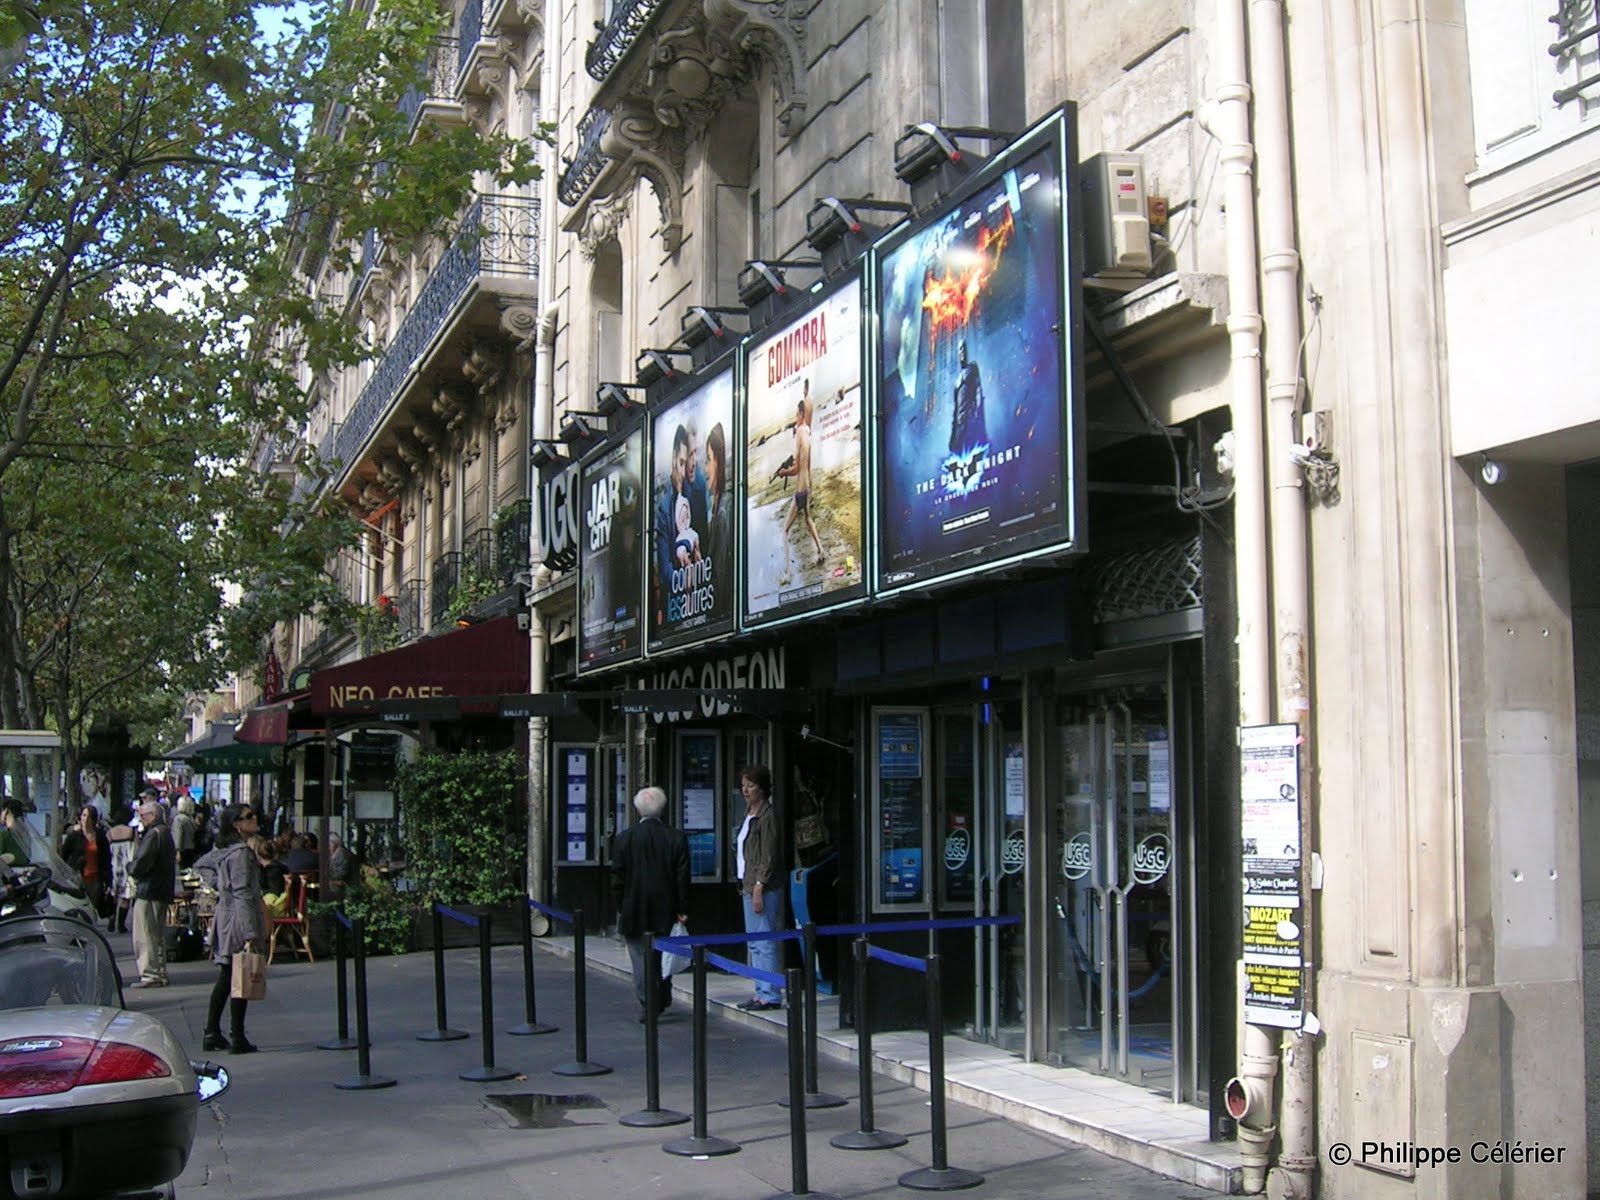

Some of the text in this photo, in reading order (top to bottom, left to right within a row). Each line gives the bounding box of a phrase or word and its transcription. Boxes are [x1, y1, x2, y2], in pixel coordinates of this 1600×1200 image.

[768, 312, 827, 388] GOMORRA
[916, 445, 1021, 495] THE DARK KNIGHT
[587, 470, 620, 528] JAR
[590, 515, 612, 551] CITY
[672, 556, 712, 593] comme
[945, 838, 967, 858] UGC
[1003, 839, 1024, 861] UGC
[1065, 842, 1092, 865] UGC
[1135, 844, 1166, 869] UGC
[1250, 907, 1293, 922] MOZART
